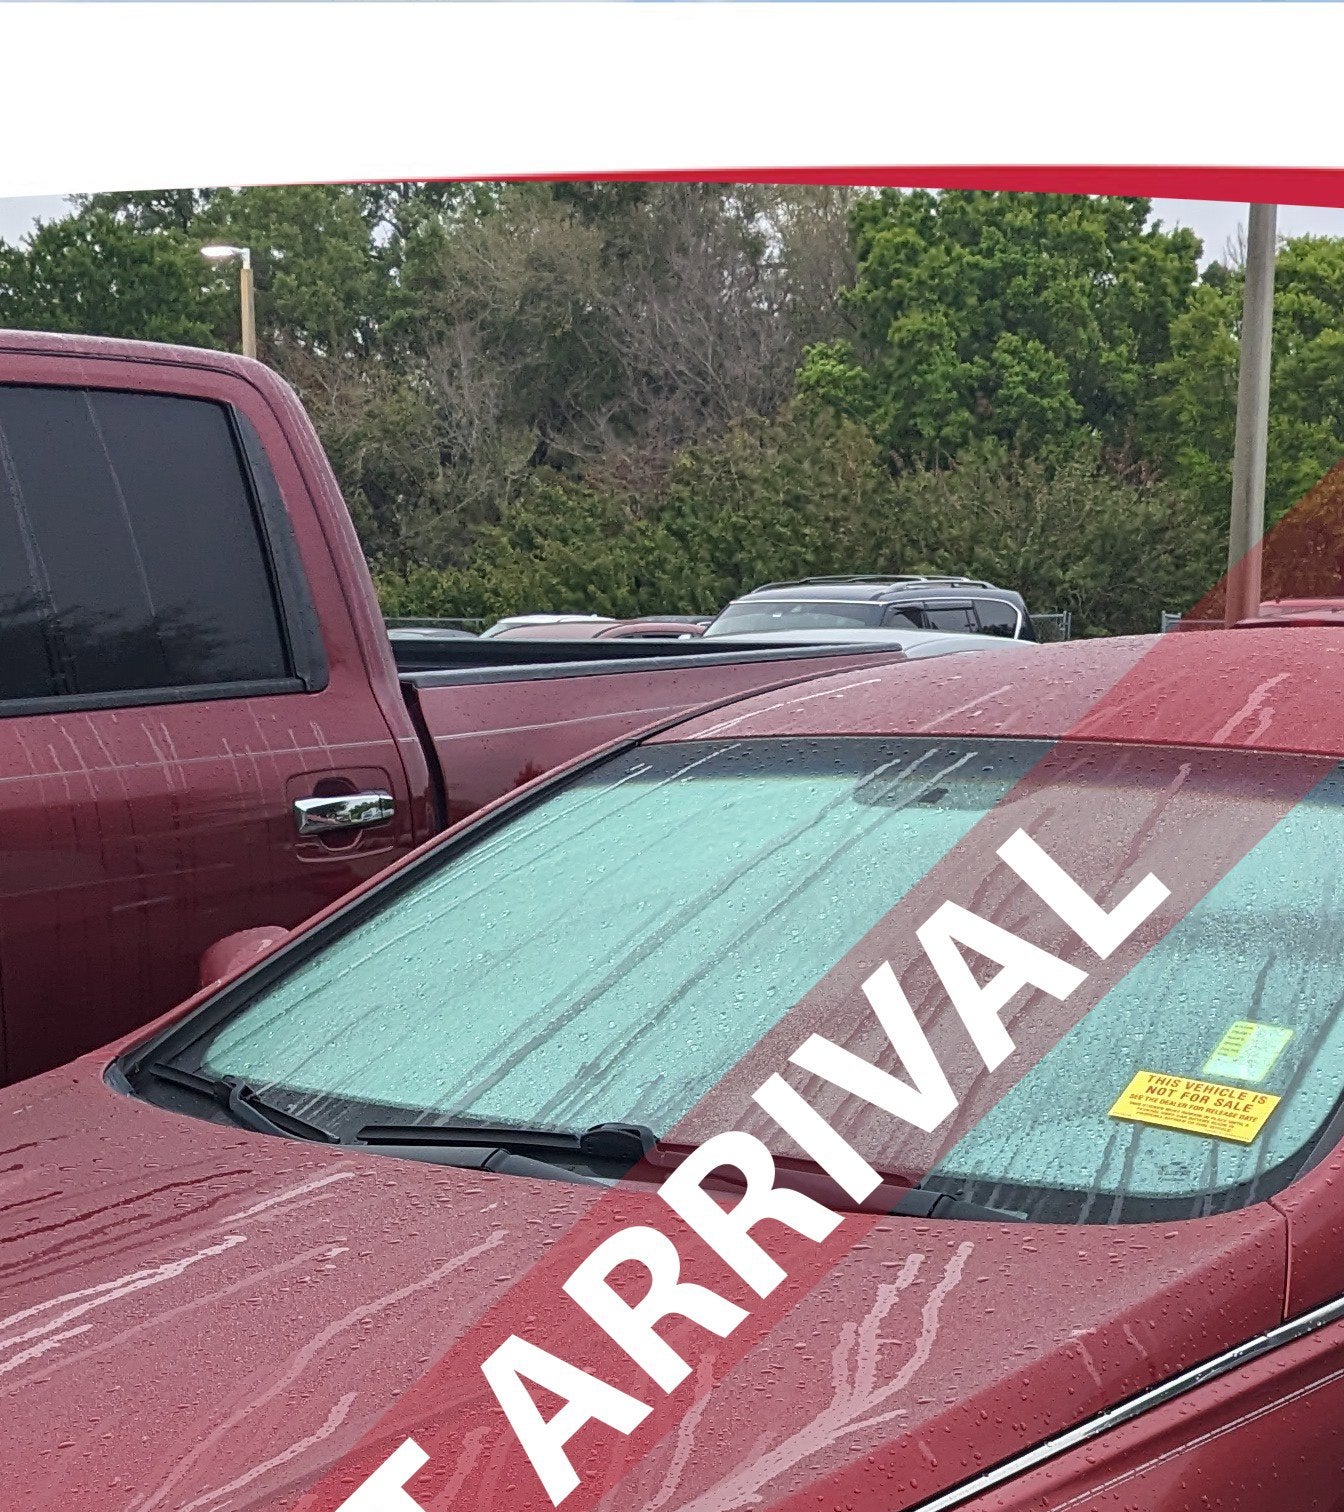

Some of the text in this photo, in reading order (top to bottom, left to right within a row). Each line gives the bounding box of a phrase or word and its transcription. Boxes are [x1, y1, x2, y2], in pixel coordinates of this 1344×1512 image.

[1145, 1085, 1254, 1113] NOT FOR SALE
[1147, 1074, 1268, 1105] THIS VEHICLE IS
